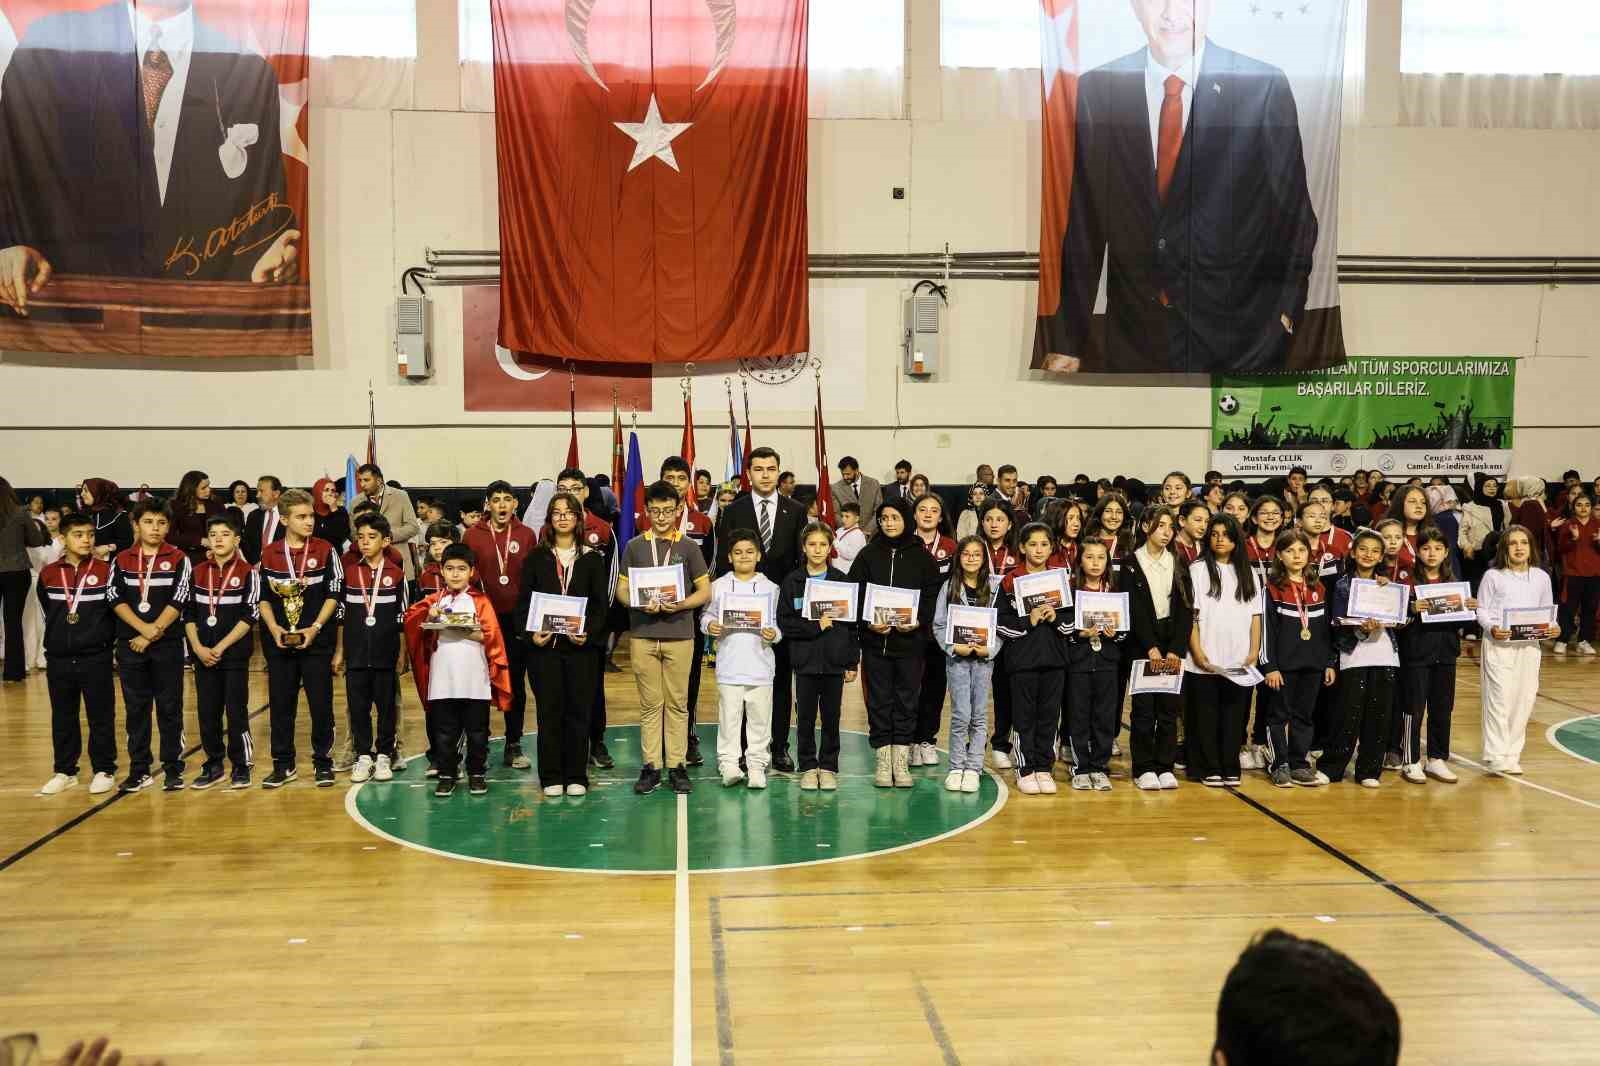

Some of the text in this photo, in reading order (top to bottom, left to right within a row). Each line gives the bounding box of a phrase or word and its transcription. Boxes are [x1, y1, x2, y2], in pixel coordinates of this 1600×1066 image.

[1361, 358, 1389, 375] TÜM
[1392, 361, 1510, 376] SPORCULARIMIZA
[1297, 377, 1430, 398] BAŞARILAR DİLERİZ.
[1243, 454, 1276, 462] Mustafa
